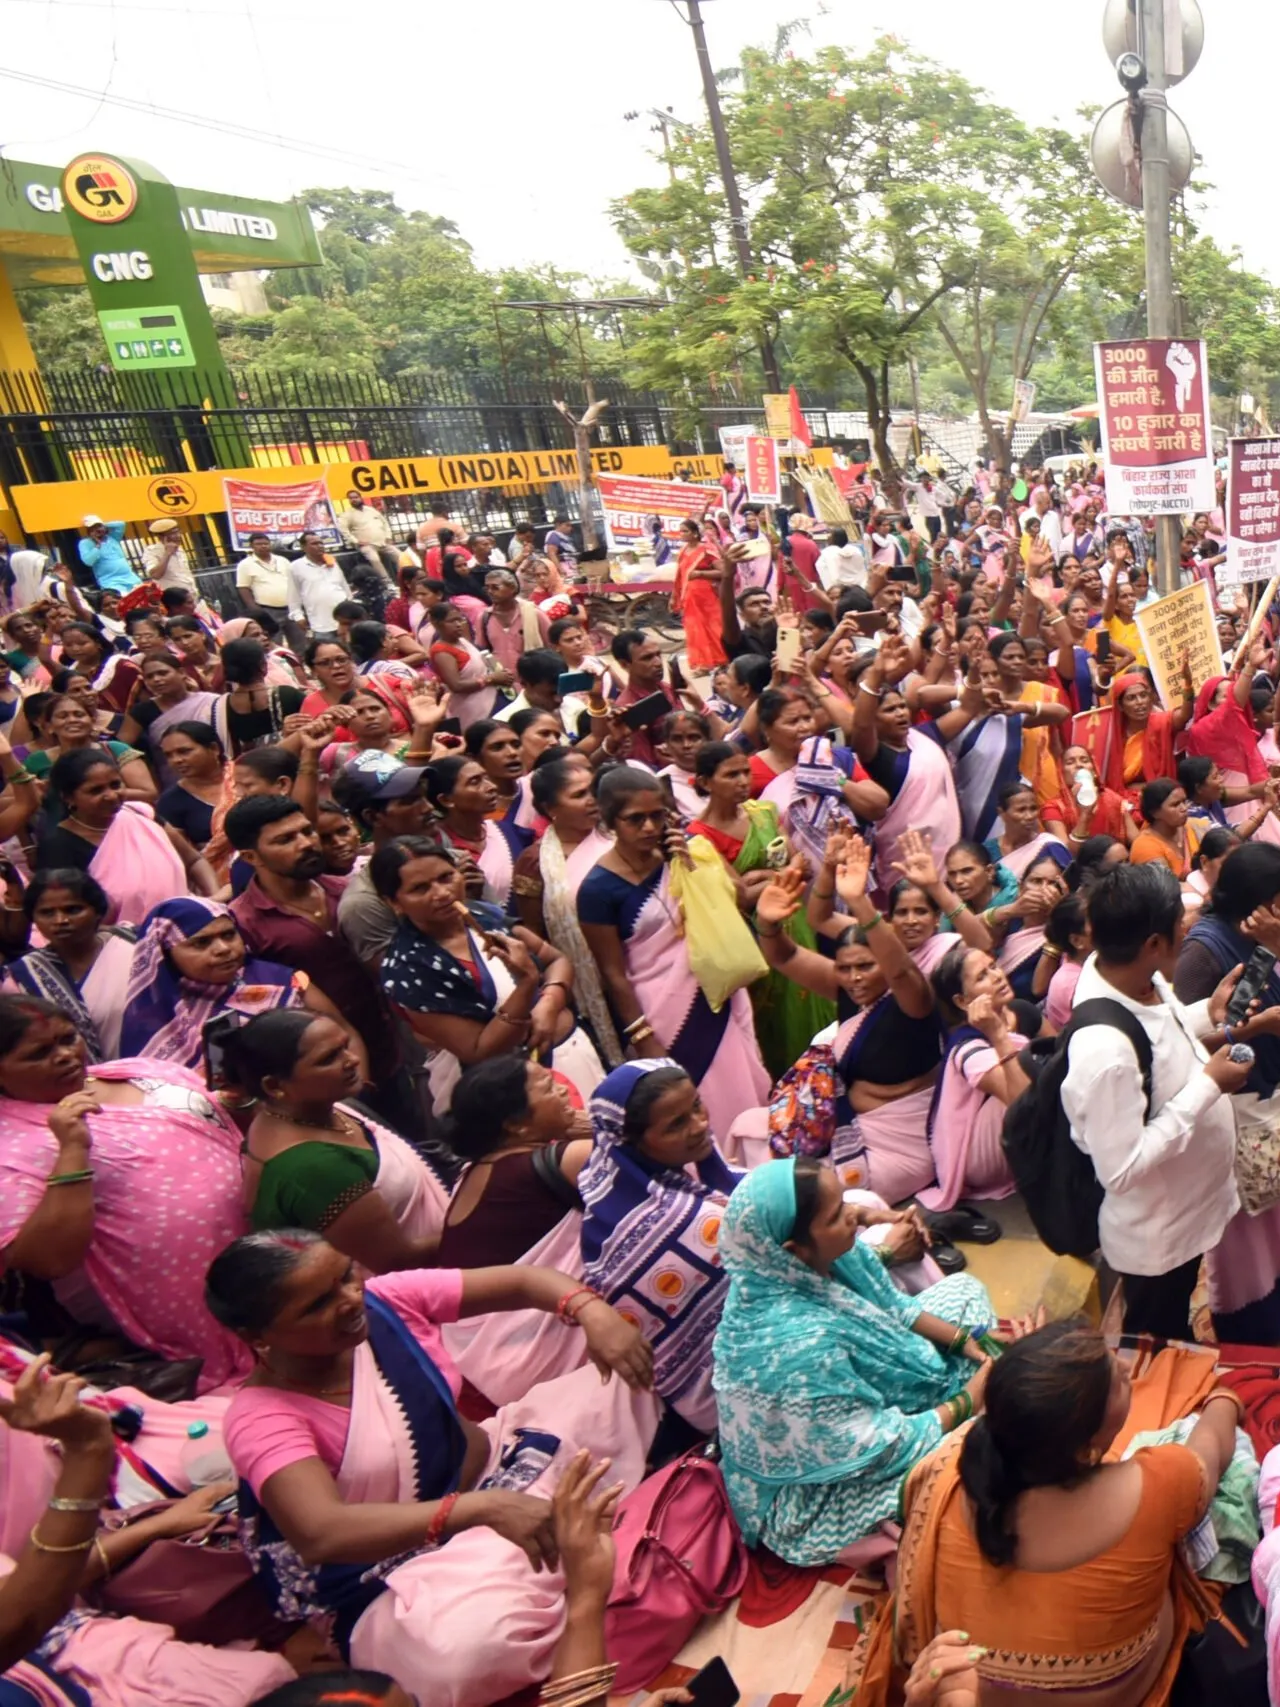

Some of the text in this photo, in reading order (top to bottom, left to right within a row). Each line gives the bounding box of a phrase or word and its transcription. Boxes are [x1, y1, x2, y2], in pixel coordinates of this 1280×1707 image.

[187, 206, 278, 240] LIMITED
[93, 251, 153, 282] CNG
[1105, 348, 1147, 364] 3000
[1106, 366, 1158, 384] की जीत
[1108, 388, 1147, 408] हमारी
[1113, 413, 1201, 431] 10 हजार का
[1110, 430, 1202, 452] संघर्ष जारी है
[351, 463, 428, 492] GAIL
[438, 454, 529, 488] (INDIA)
[673, 459, 711, 477] GAIL
[754, 438, 770, 493] AICCTU
[1122, 468, 1147, 482] बिहार
[1149, 469, 1171, 481] राज्य
[1152, 601, 1177, 619] 3000
